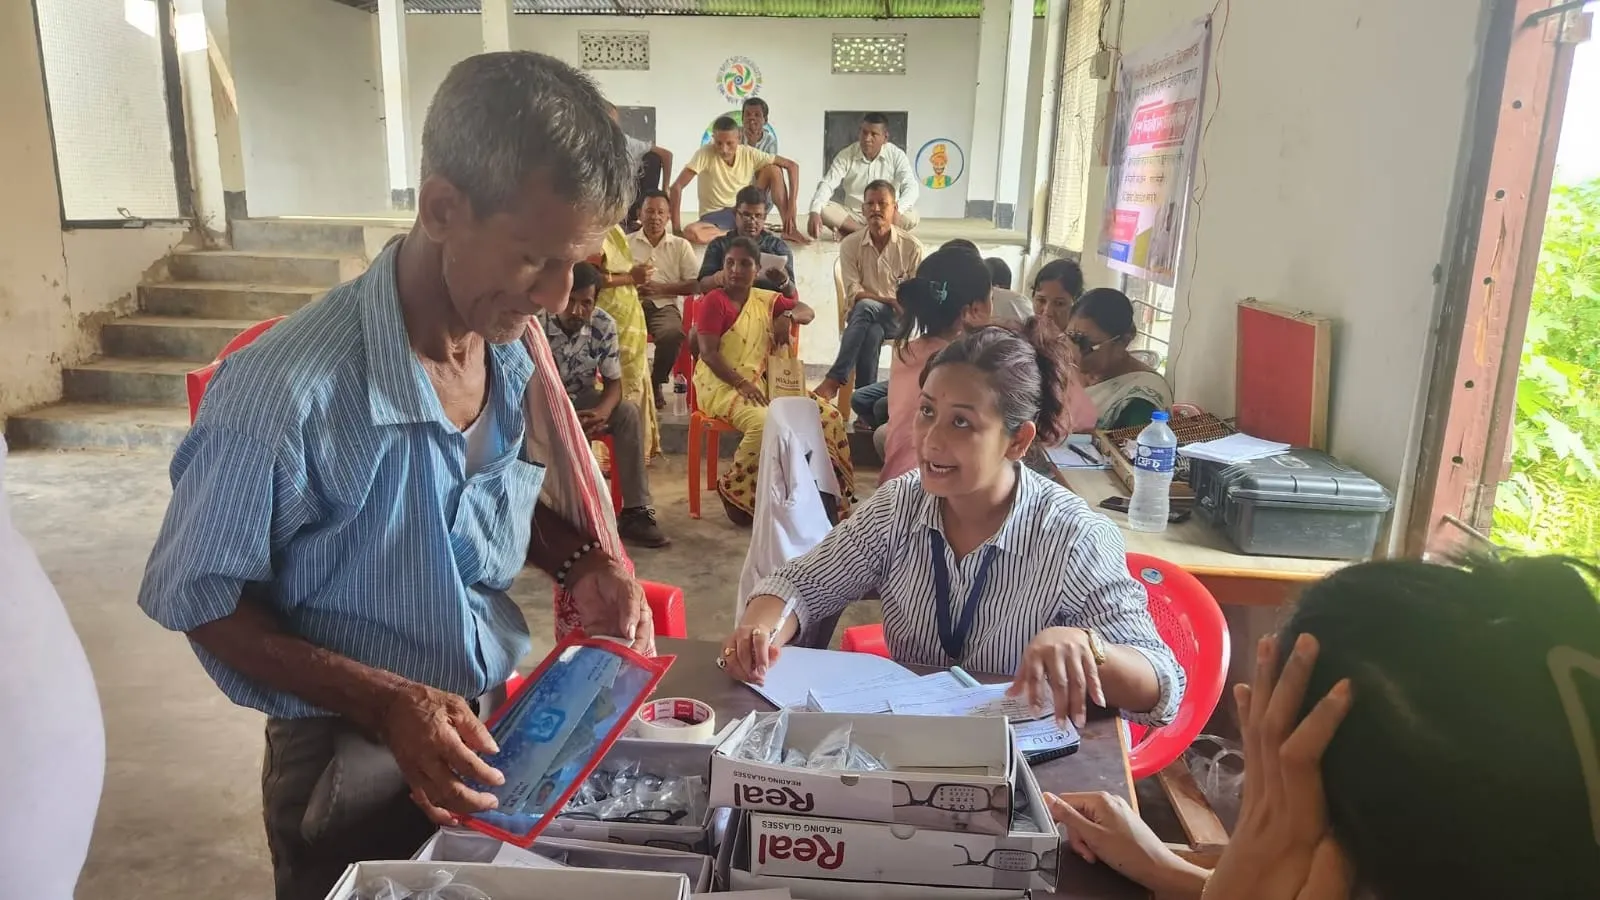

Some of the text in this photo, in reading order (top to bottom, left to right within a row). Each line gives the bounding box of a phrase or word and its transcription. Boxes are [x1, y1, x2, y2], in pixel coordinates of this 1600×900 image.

[733, 771, 802, 786] READING GLASSES
[733, 783, 814, 812] Real
[762, 820, 843, 834] READING GLASSES
[758, 834, 845, 870] Real
